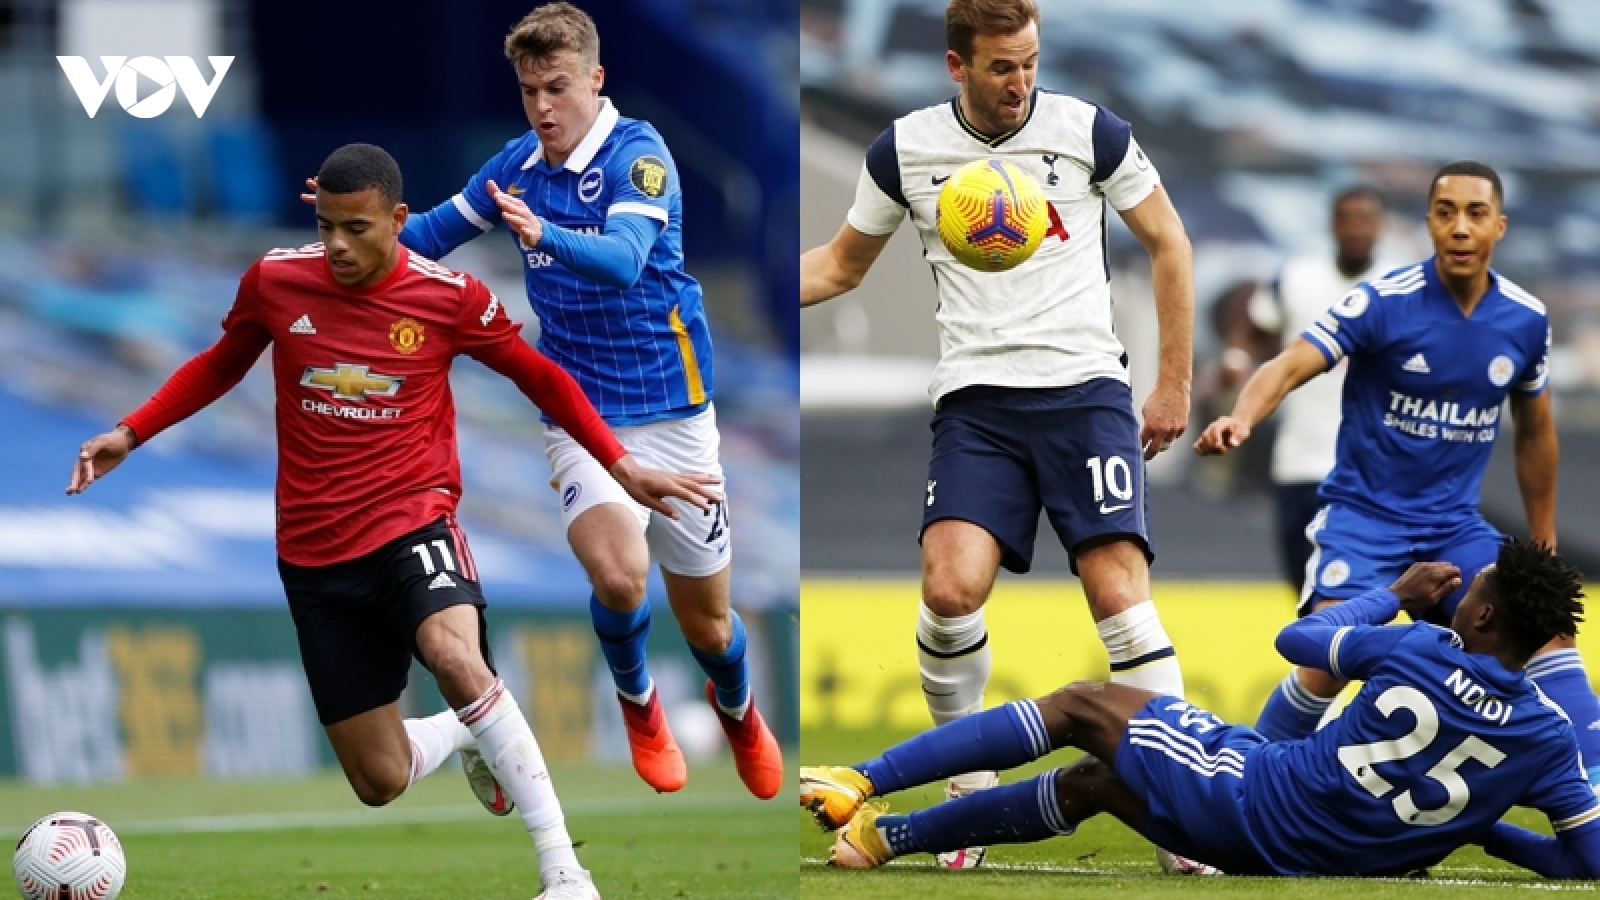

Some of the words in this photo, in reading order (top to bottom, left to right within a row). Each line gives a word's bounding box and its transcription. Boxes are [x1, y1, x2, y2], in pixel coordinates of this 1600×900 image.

[301, 399, 403, 419] CHEVROLET
[1384, 413, 1438, 438] SMILES
[1085, 455, 1133, 502] 10
[411, 539, 456, 576] 11
[1443, 667, 1513, 727] NDIDI
[1337, 685, 1508, 827] 25
